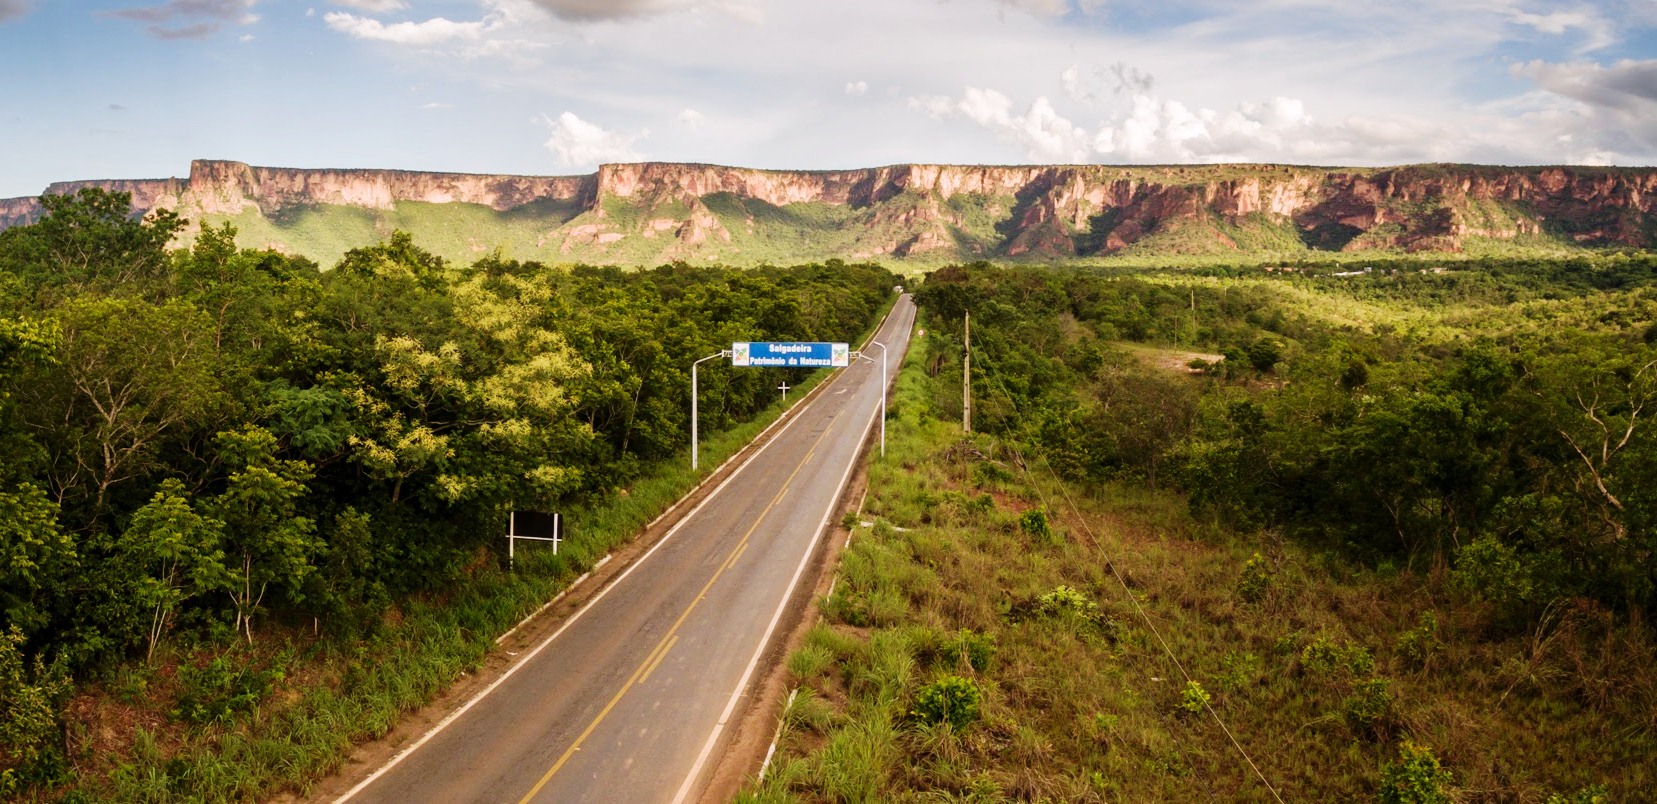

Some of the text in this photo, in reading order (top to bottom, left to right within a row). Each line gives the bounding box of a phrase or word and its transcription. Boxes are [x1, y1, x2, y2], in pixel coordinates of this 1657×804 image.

[769, 344, 812, 354] Salgadeira
[750, 357, 831, 365] Patrimônio da Natureza
